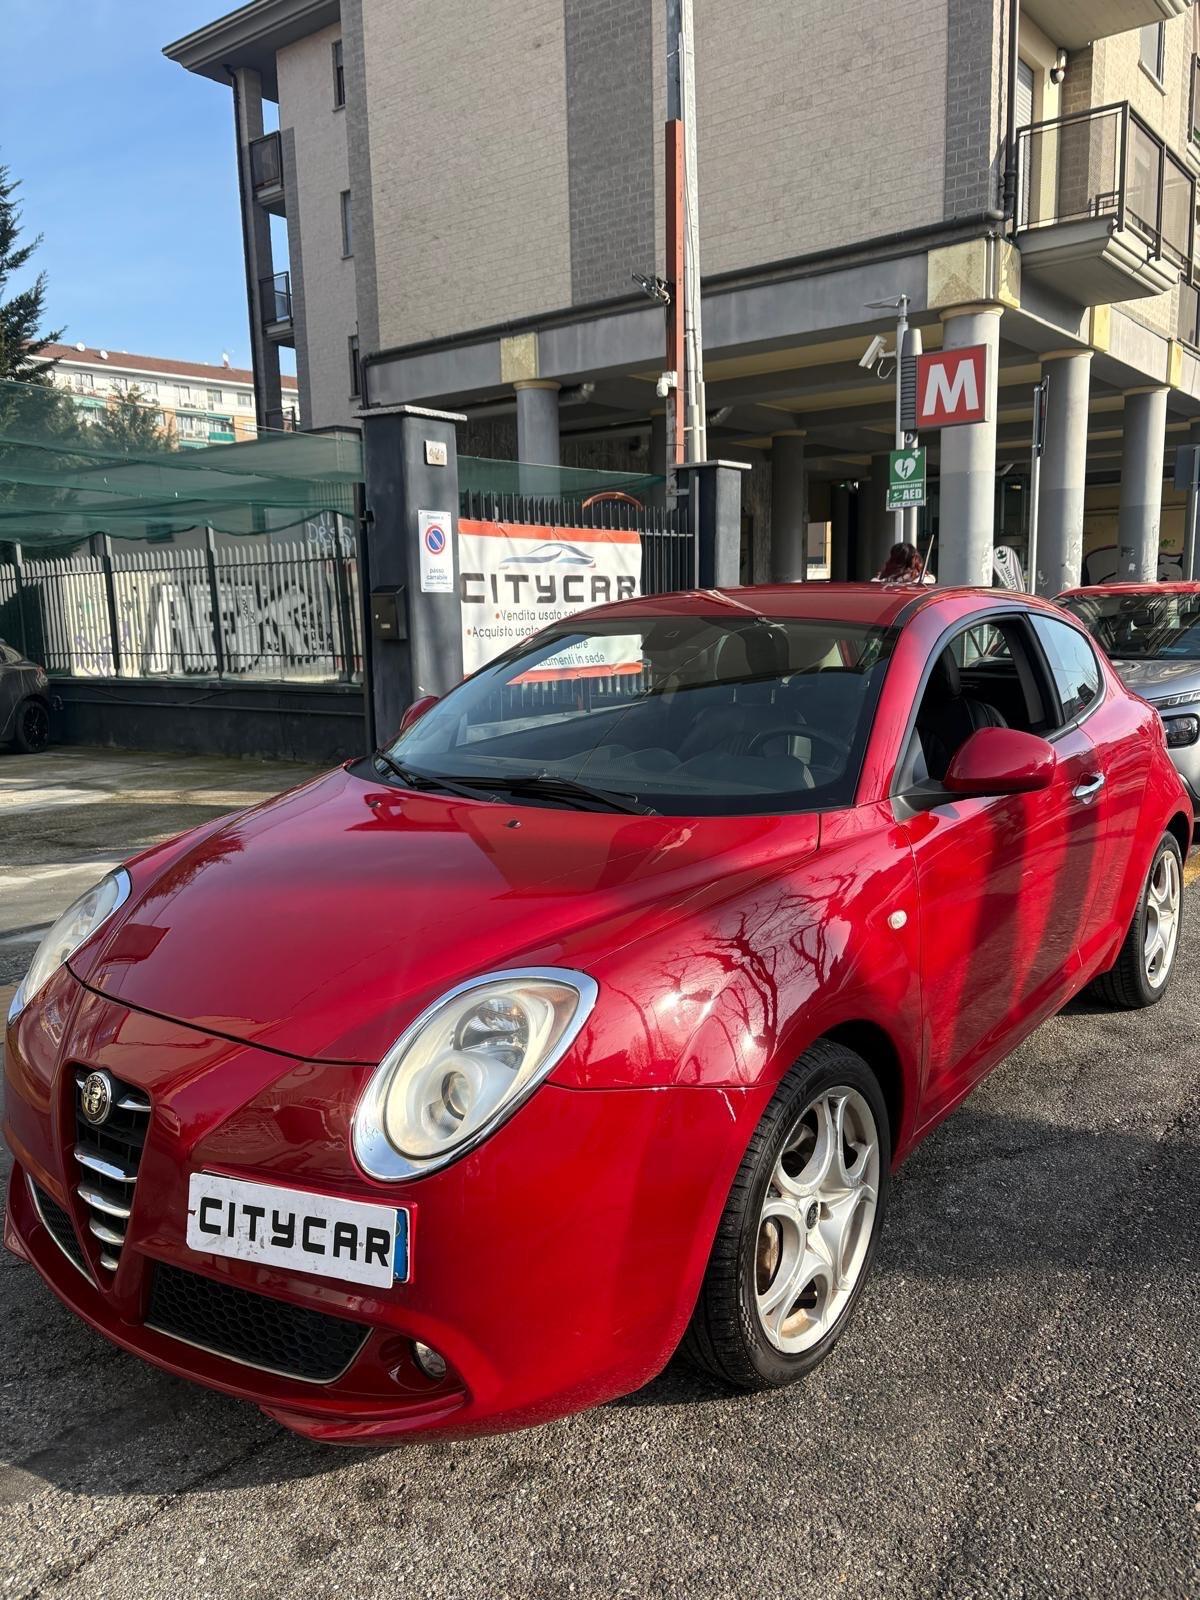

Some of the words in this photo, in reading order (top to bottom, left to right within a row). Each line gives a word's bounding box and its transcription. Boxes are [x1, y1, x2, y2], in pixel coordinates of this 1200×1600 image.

[922, 358, 980, 417] M
[902, 488, 922, 500] AED
[460, 572, 636, 604] CITYCAR
[500, 609, 536, 621] Vendita
[538, 609, 562, 620] usato
[472, 625, 514, 640] Acquisto
[575, 652, 584, 665] in
[585, 652, 605, 664] sede
[199, 1196, 391, 1267] CITYCAR
